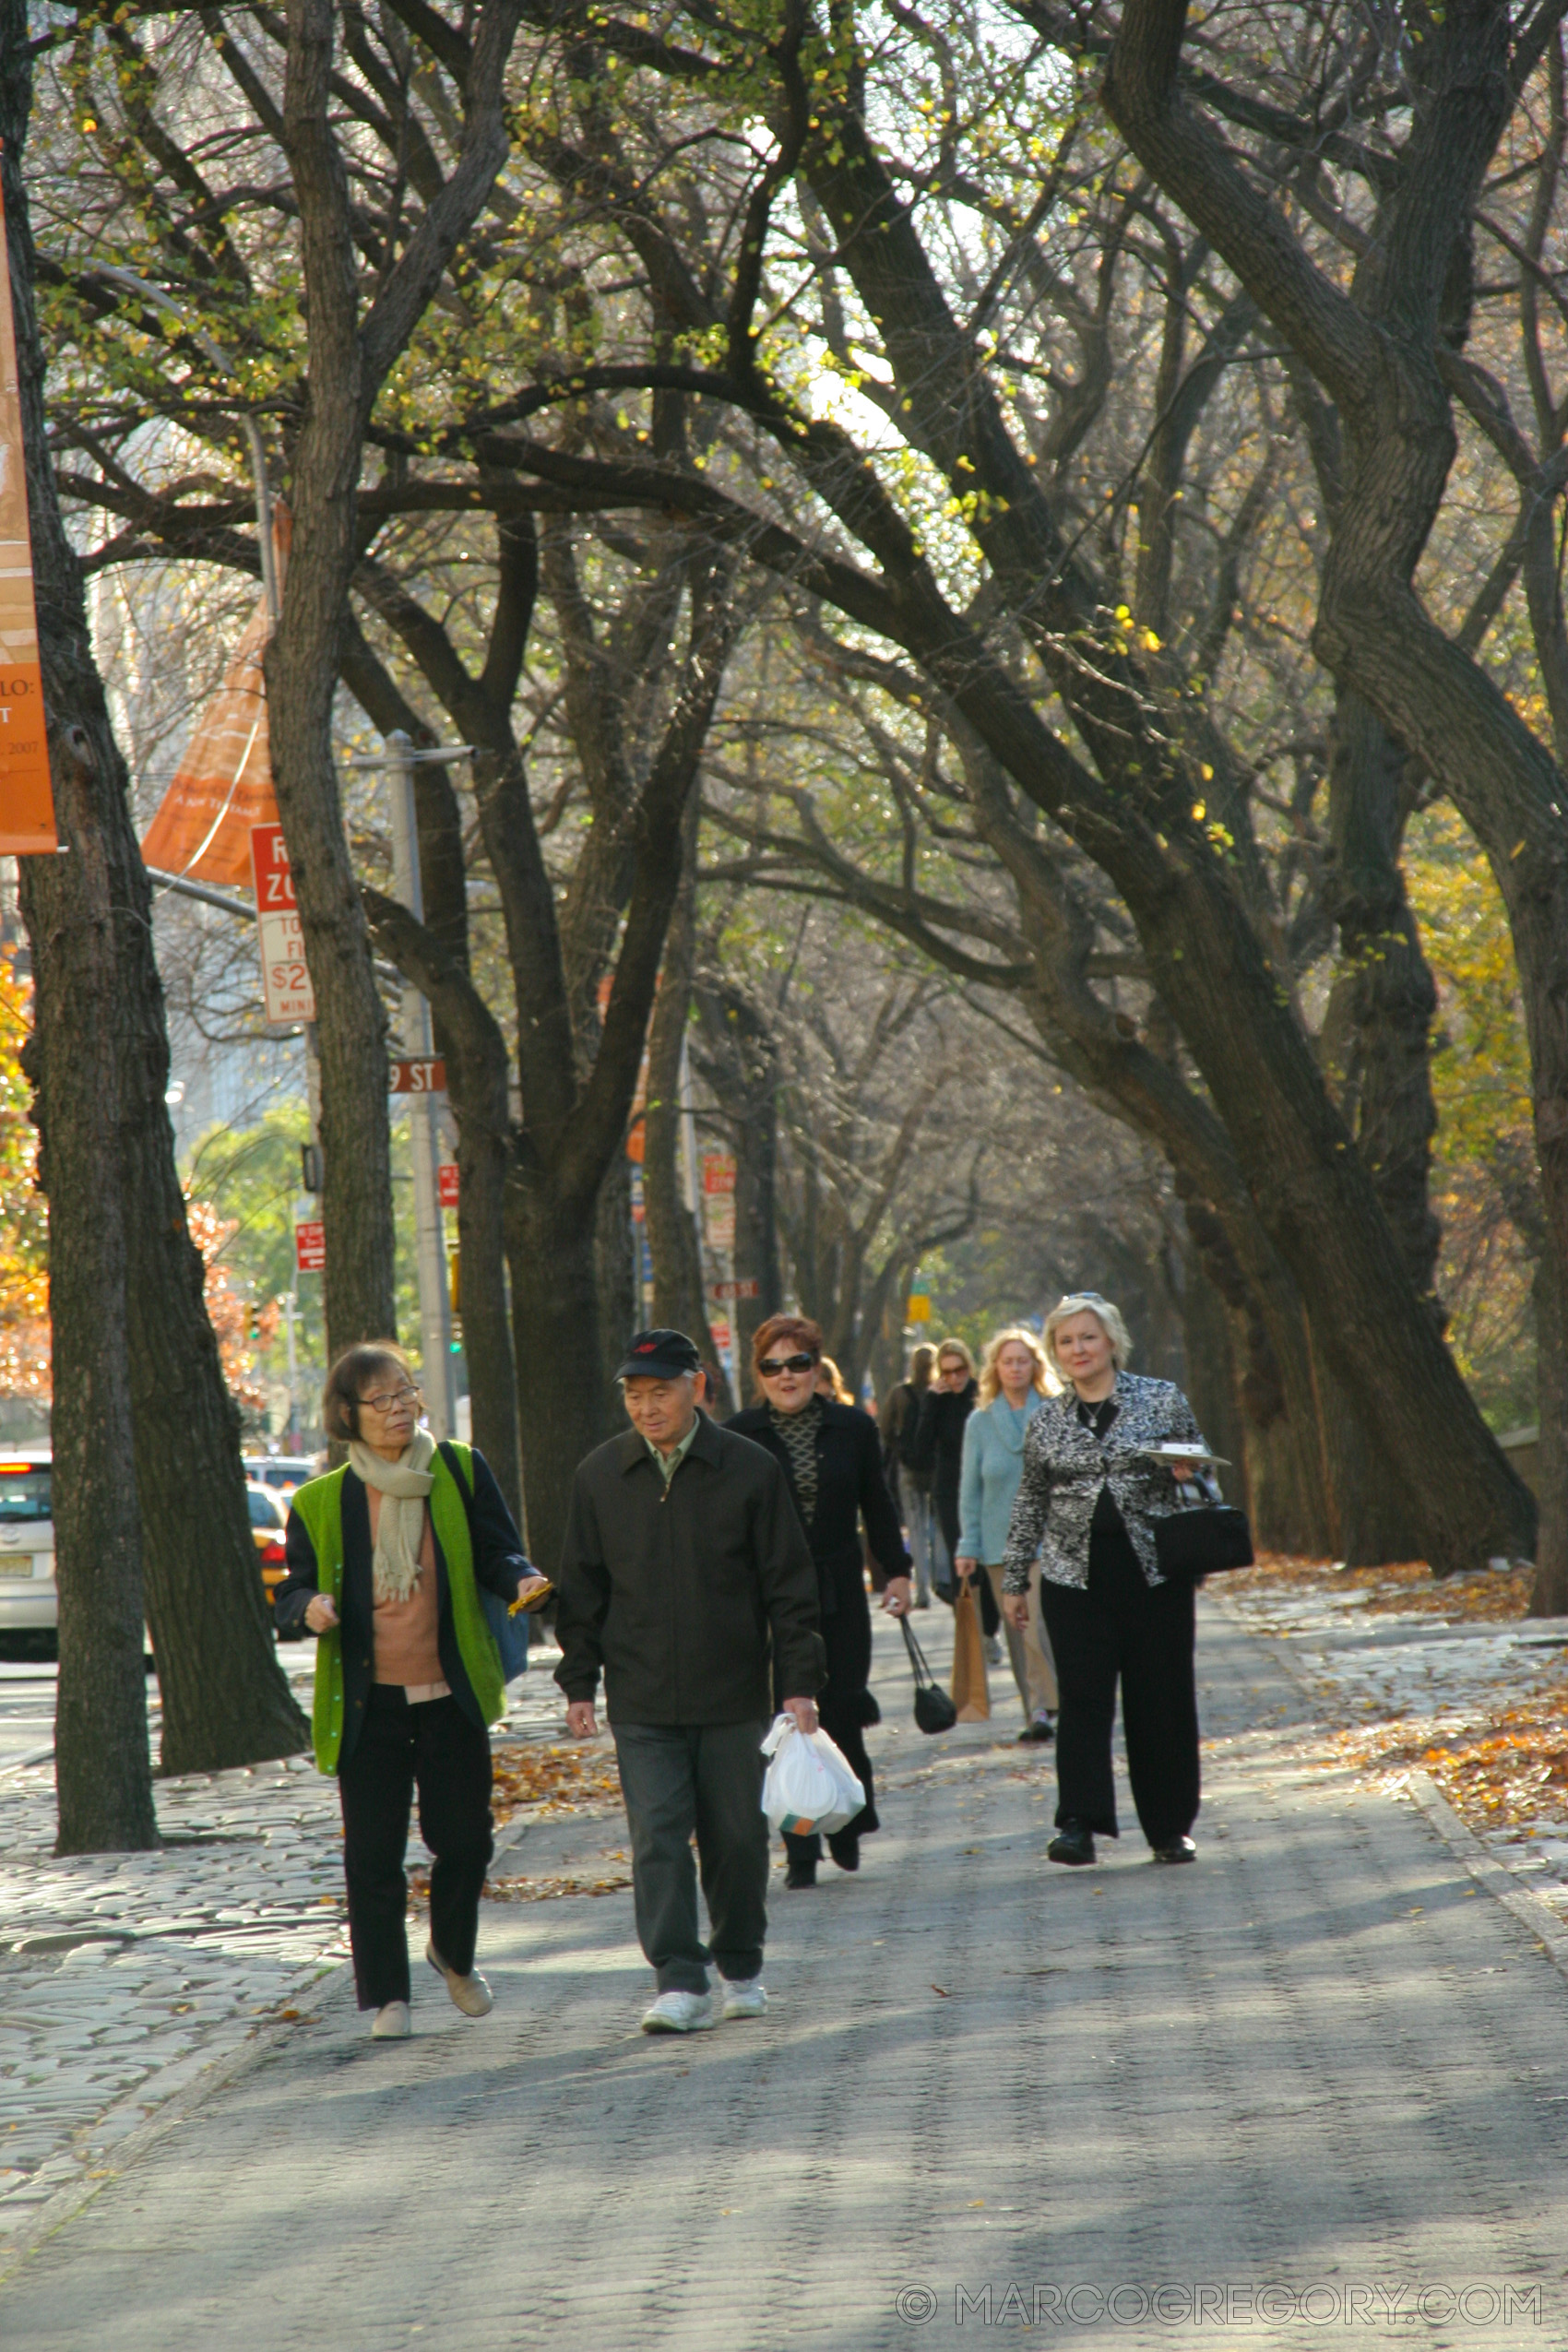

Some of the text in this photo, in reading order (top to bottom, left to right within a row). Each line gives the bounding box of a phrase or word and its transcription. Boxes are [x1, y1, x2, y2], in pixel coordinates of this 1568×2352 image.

[8, 742, 38, 755] 2007
[271, 964, 306, 991] $2
[410, 1063, 434, 1092] ST
